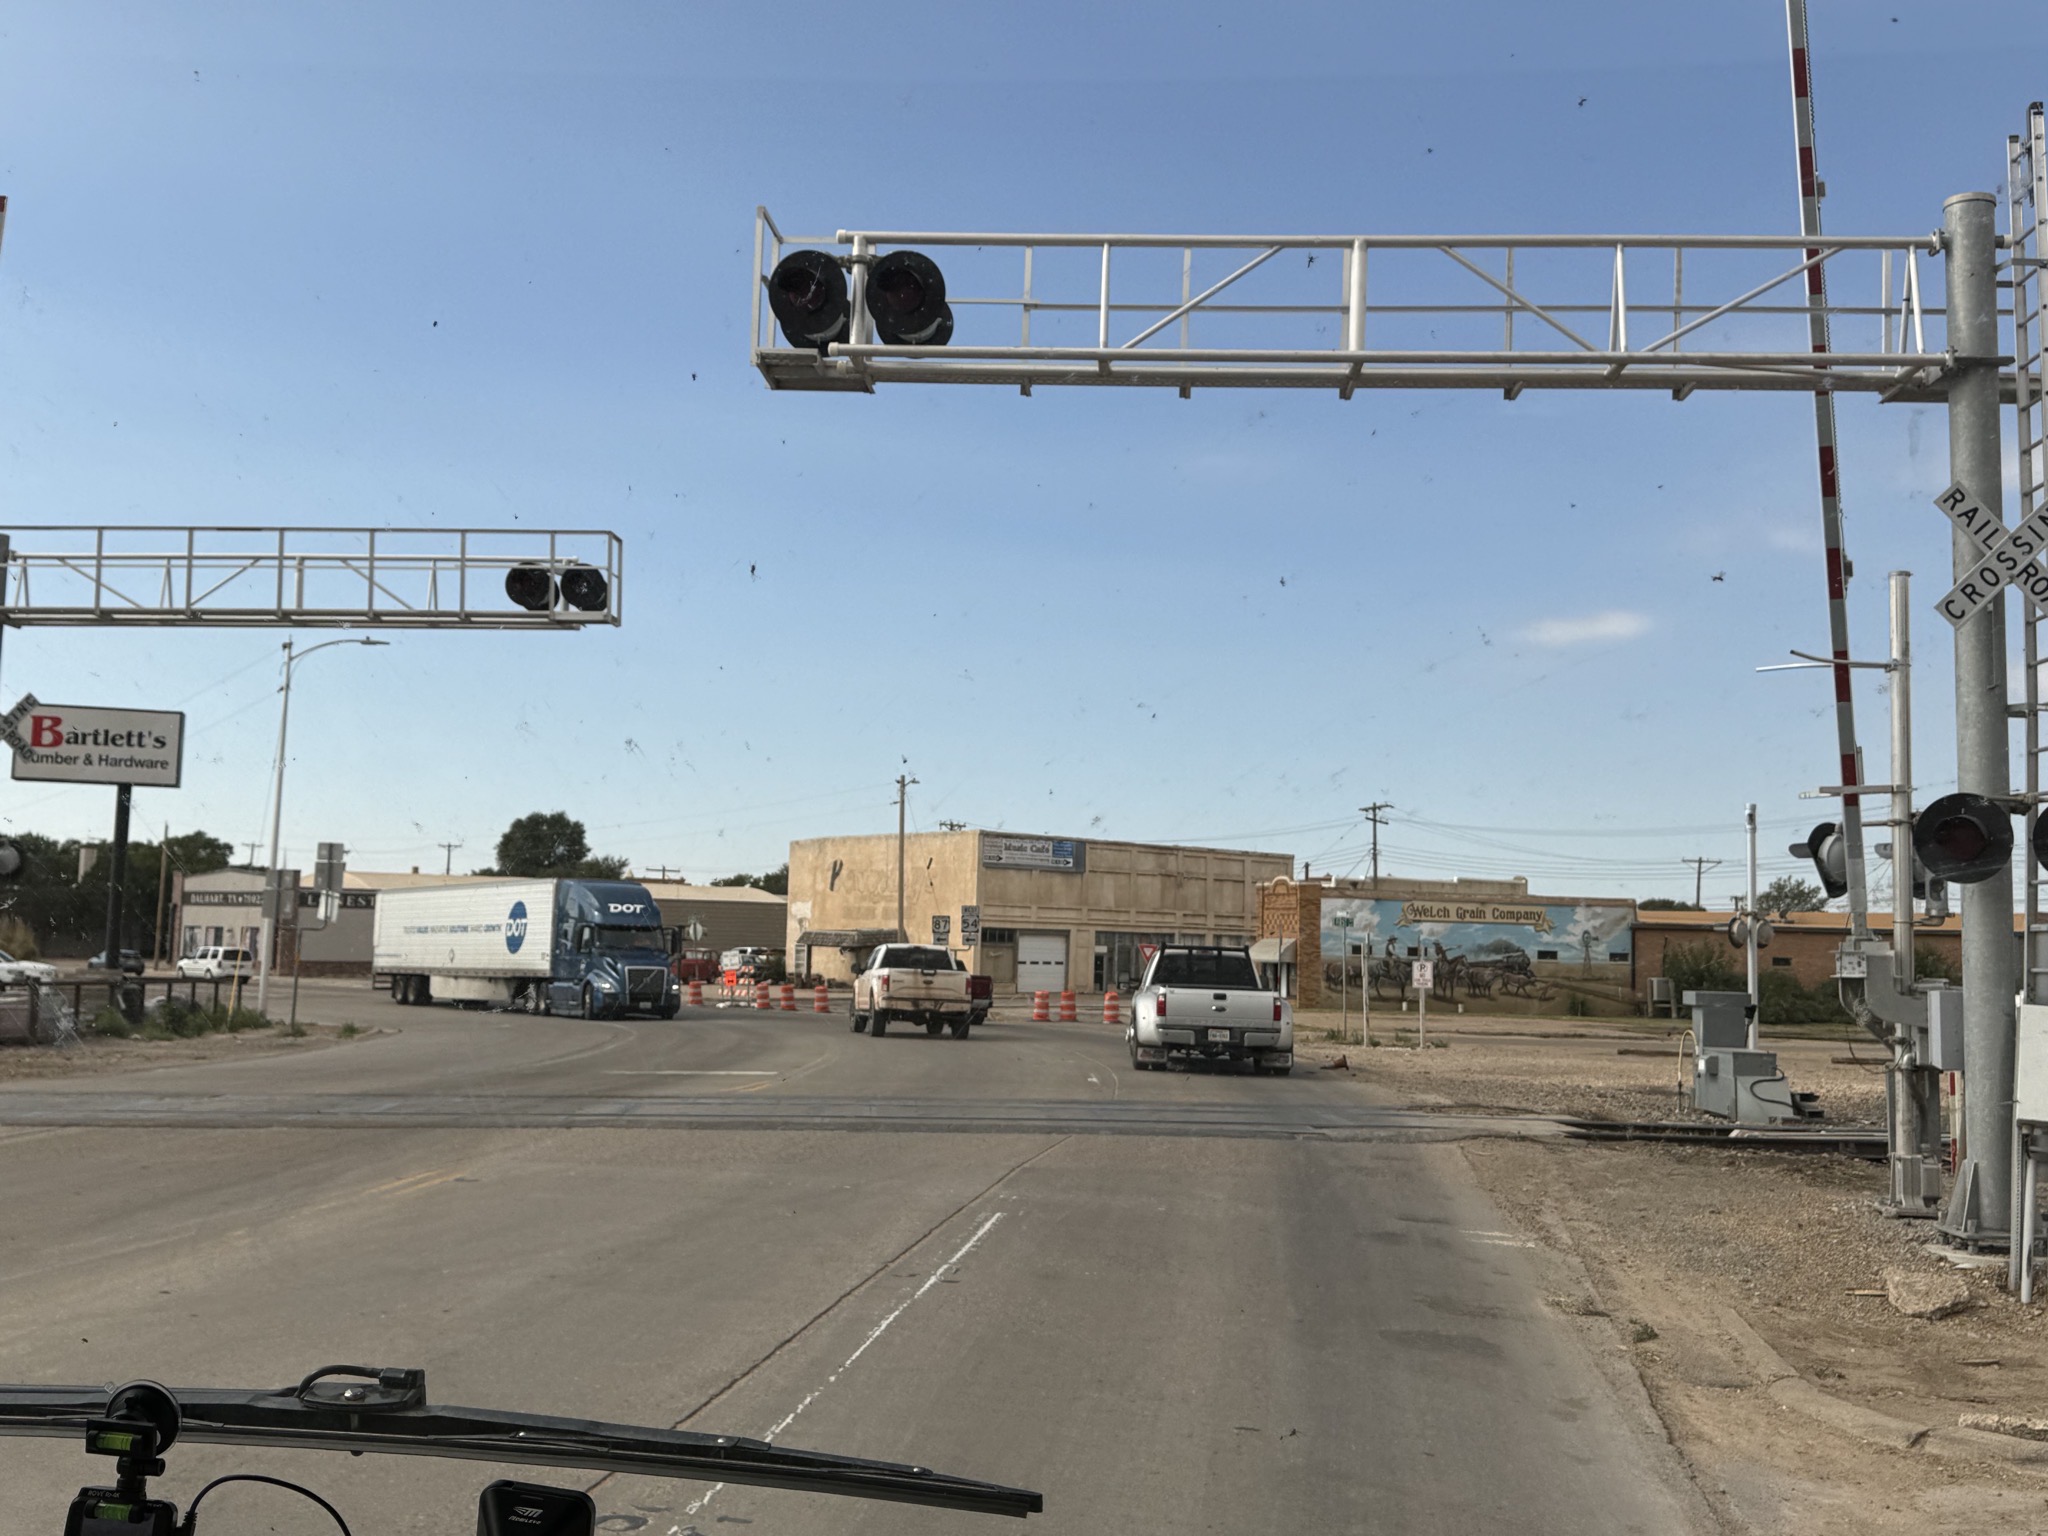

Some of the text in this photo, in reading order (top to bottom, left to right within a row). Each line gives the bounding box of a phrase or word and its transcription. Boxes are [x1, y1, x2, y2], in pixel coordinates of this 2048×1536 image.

[1942, 488, 2048, 604] RAIL RO
[30, 715, 167, 749] Bartlett's
[5, 729, 34, 760] ROAD
[31, 752, 169, 770] umber & Hardware
[607, 903, 646, 914] DOT
[1456, 906, 1486, 920] Grain
[1492, 906, 1543, 922] Company
[506, 918, 528, 937] DOT
[934, 919, 948, 930] 87
[962, 918, 978, 929] 54
